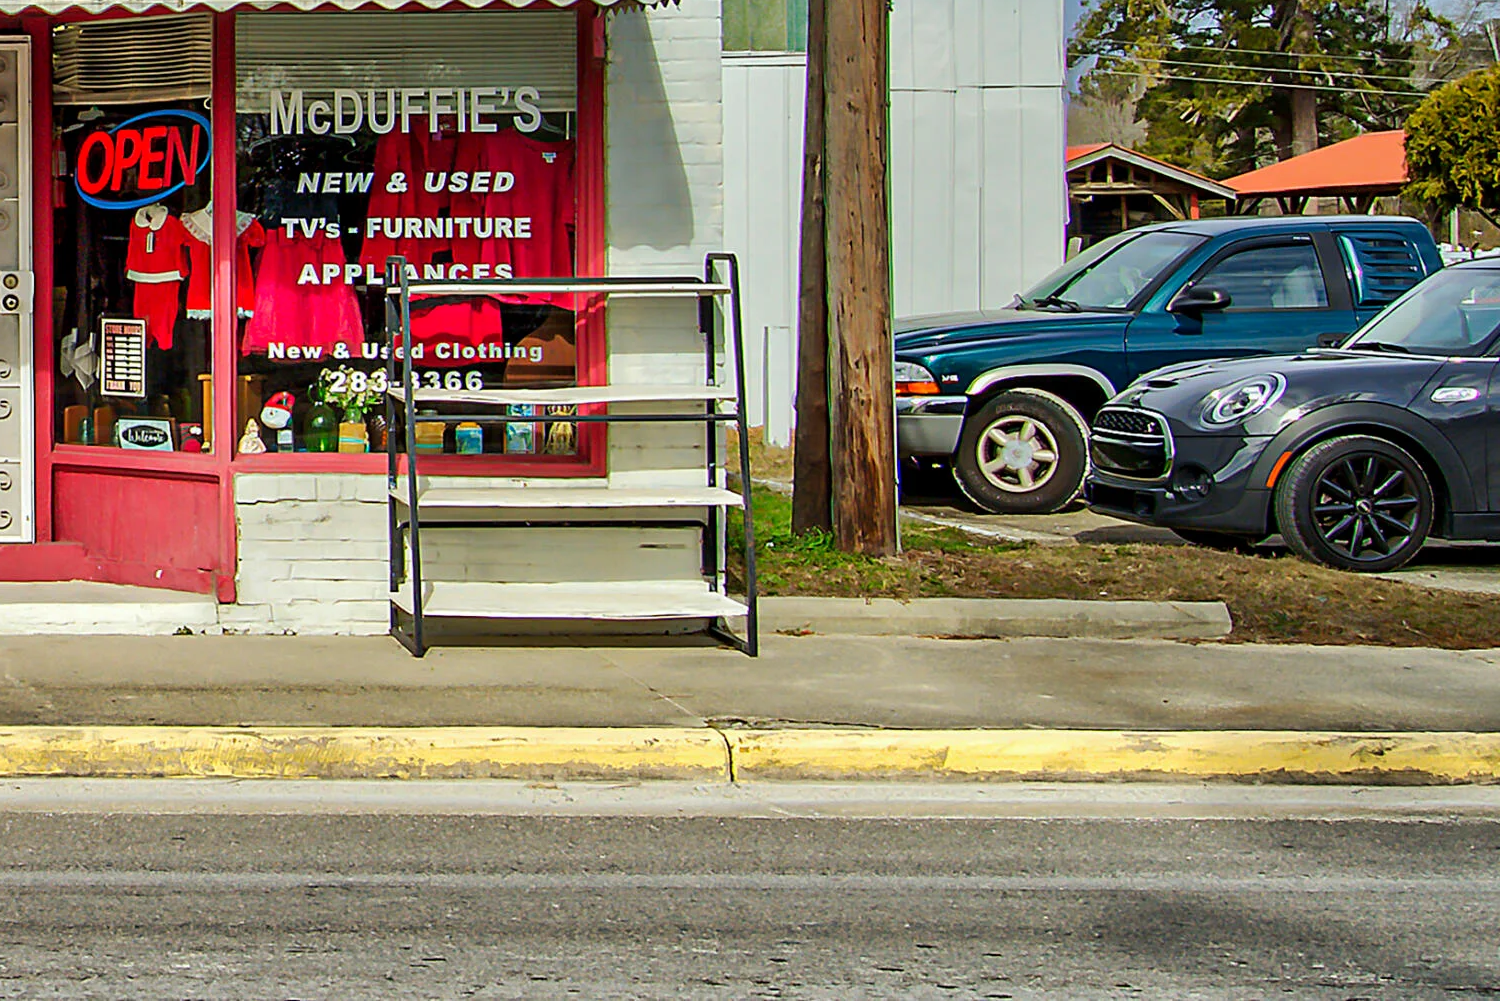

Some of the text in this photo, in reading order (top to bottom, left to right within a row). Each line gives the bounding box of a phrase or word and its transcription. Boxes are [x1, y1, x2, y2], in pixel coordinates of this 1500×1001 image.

[269, 86, 542, 135] McDUFFIE'S
[77, 124, 200, 195] OPEN
[297, 171, 515, 193] NEW & USED
[281, 217, 341, 239] TV's
[366, 217, 532, 239] FURNITURE
[268, 342, 543, 362] New & Used Clothing
